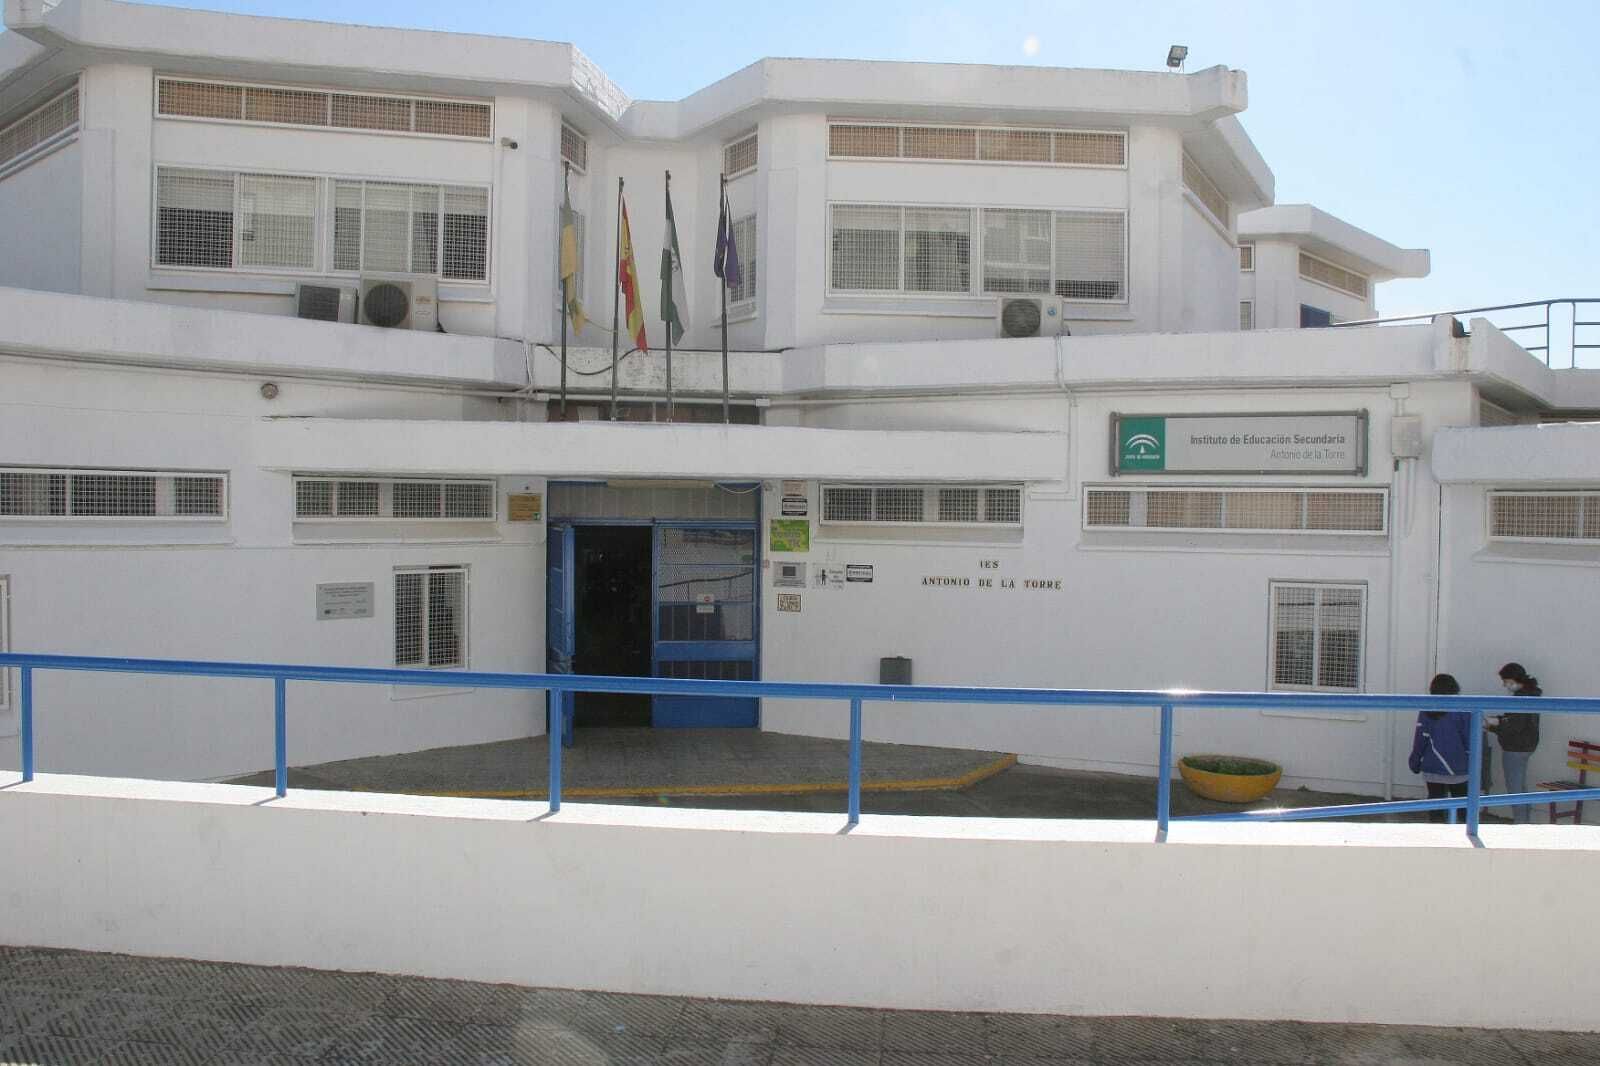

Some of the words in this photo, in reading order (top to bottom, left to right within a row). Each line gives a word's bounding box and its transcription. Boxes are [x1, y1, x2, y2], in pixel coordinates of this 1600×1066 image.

[1190, 434, 1228, 445] Instituto
[1230, 434, 1241, 445] de
[1243, 433, 1291, 445] Educación
[1293, 433, 1345, 445] Secundaria
[1270, 449, 1300, 460] Antonio
[1302, 449, 1313, 460] de
[1314, 449, 1322, 460] la
[1324, 449, 1345, 460] Torre
[980, 560, 999, 569] IES
[922, 577, 970, 586] ANTONIO
[979, 579, 993, 588] DE
[1001, 580, 1015, 589] LA
[1024, 580, 1063, 590] TORRE
